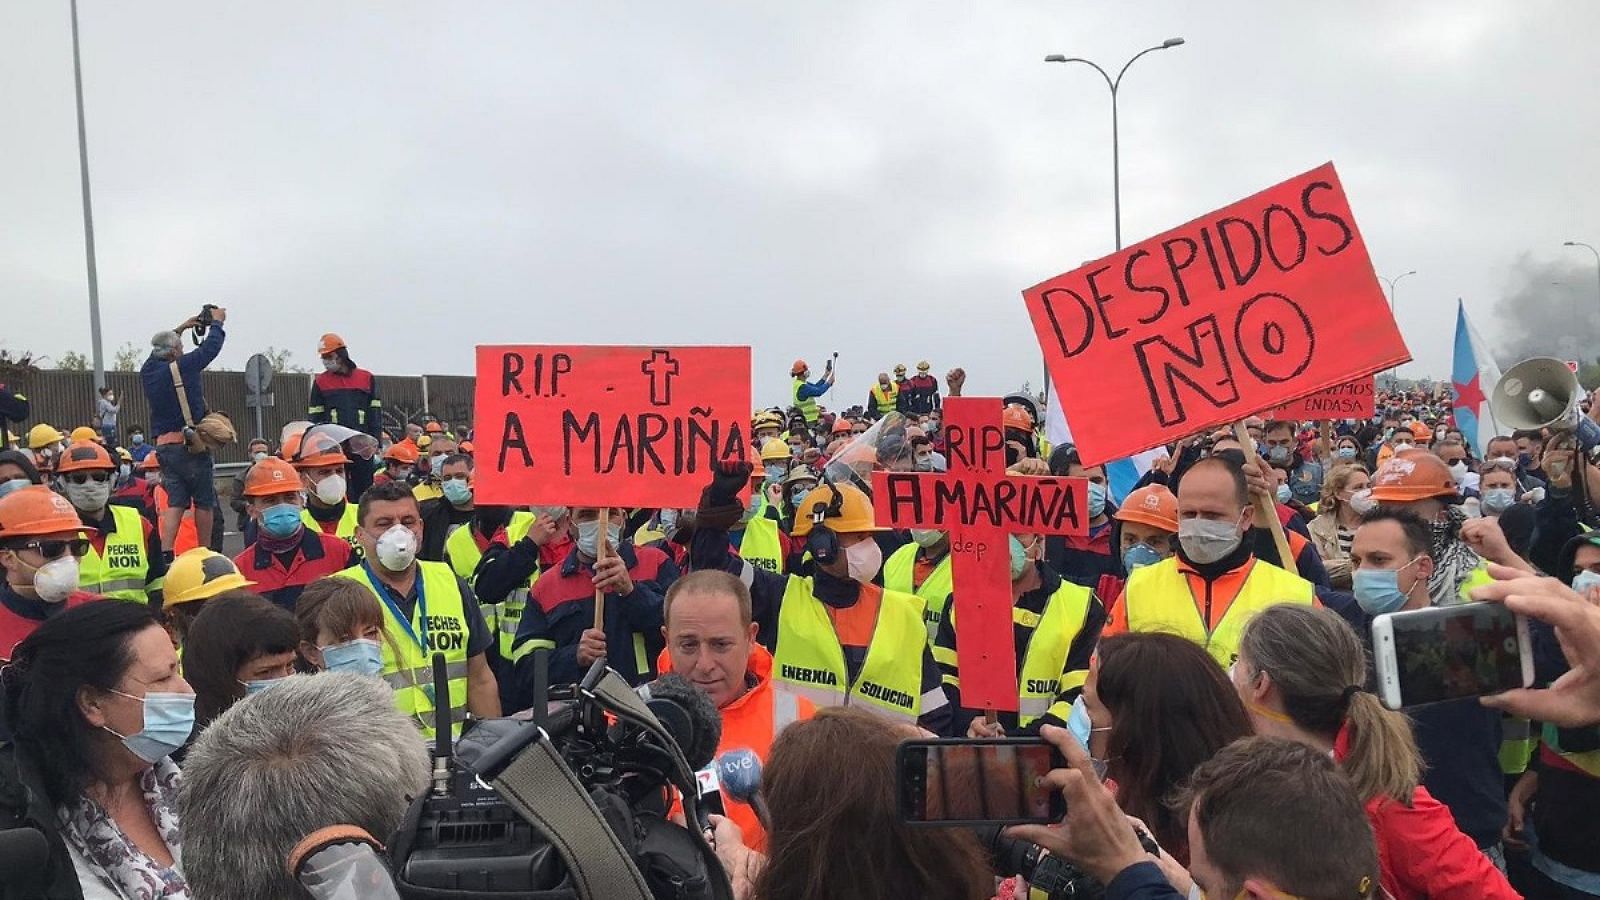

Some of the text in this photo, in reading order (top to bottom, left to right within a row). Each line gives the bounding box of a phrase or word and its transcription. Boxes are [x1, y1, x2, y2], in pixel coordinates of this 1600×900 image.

[1041, 182, 1353, 358] DESPIDOS
[1133, 292, 1315, 428] NO
[1304, 399, 1364, 412] ENDASA
[497, 406, 747, 477] A MARIÑA
[887, 475, 1080, 530] A MARIÑA
[108, 544, 139, 555] PECHES
[108, 555, 141, 569] NON
[743, 557, 777, 570] ECHES
[782, 663, 837, 686] ENERXÍA
[860, 680, 914, 709] SOLUCIÓN
[725, 757, 752, 773] tve
